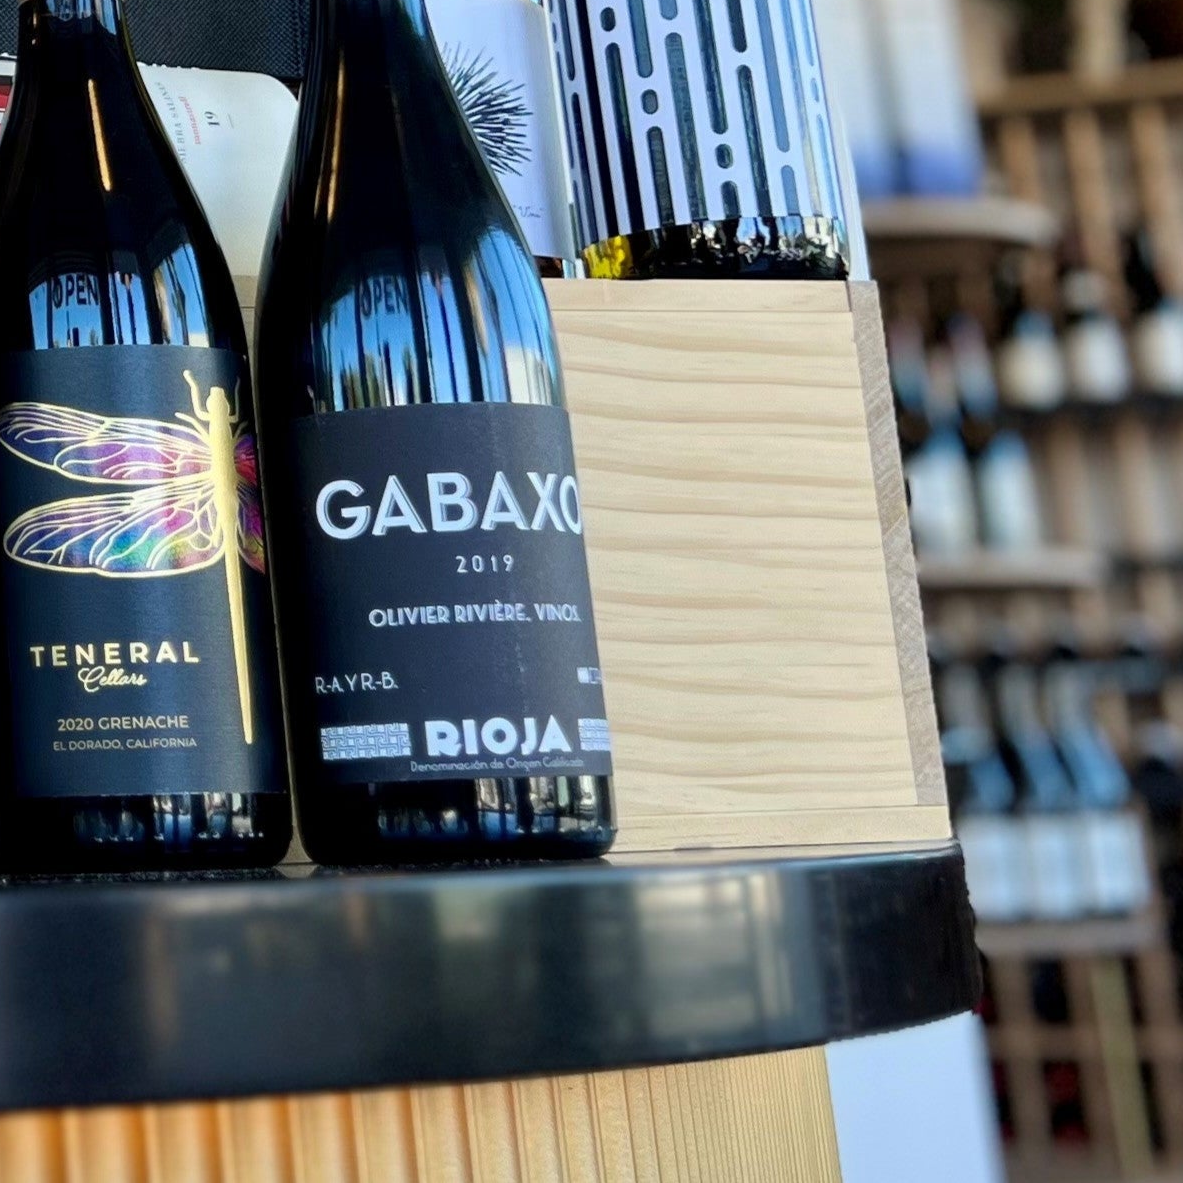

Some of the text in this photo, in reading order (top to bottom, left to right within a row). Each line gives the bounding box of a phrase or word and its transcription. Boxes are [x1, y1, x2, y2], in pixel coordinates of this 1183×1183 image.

[53, 273, 99, 310] OPEN
[358, 274, 409, 319] OPEN
[316, 469, 584, 540] GABAXO
[455, 554, 515, 574] 2019
[368, 605, 451, 628] OLIVIER
[29, 640, 200, 667] TENERAL
[77, 665, 148, 693] Cellars
[56, 714, 190, 732] 2020 GRENACHE
[423, 714, 573, 758] RIOJA
[52, 739, 67, 752] EL
[125, 737, 198, 750] CALIFORNIA
[409, 759, 489, 773] Denominación
[489, 757, 505, 770] de
